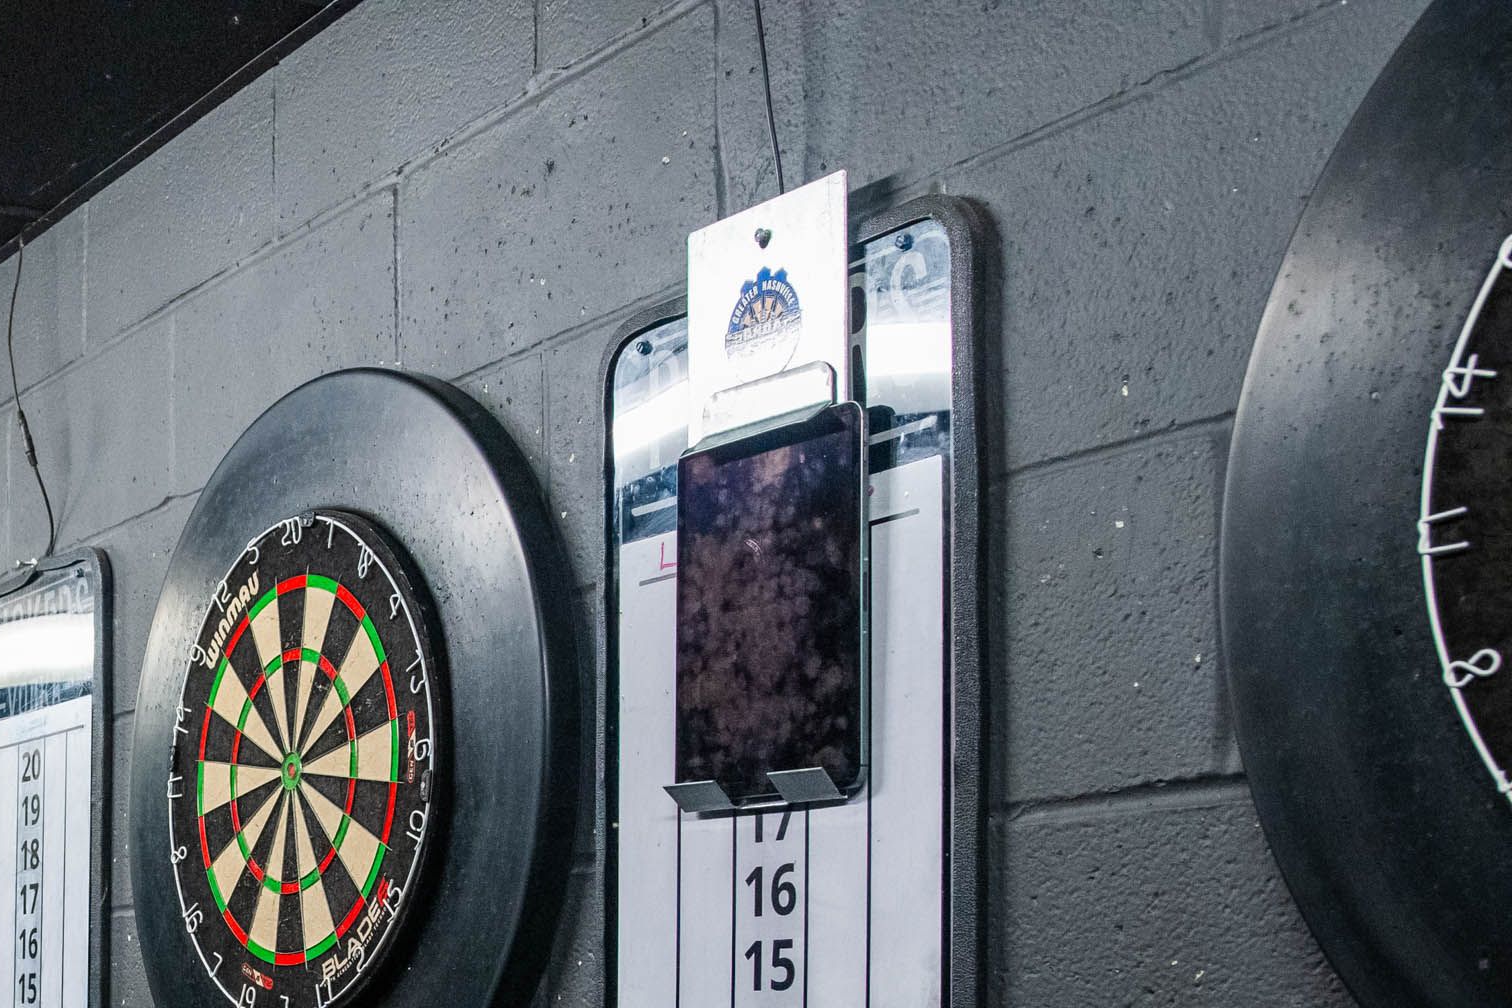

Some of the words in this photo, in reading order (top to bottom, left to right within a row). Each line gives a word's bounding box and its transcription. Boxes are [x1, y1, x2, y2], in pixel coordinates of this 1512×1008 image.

[732, 286, 759, 324] GREATER
[762, 279, 797, 306] NASHVILLE
[1431, 353, 1498, 430] 14
[281, 518, 302, 547] 20
[211, 579, 233, 613] 12
[1444, 646, 1503, 691] 8
[21, 748, 41, 783] 20
[21, 793, 40, 826] 19
[21, 838, 39, 871] 18
[171, 845, 188, 864] 8
[20, 883, 39, 914] 17
[745, 862, 797, 917] 16
[19, 927, 38, 960] 16
[744, 938, 795, 992] 15
[18, 973, 37, 1005] 15
